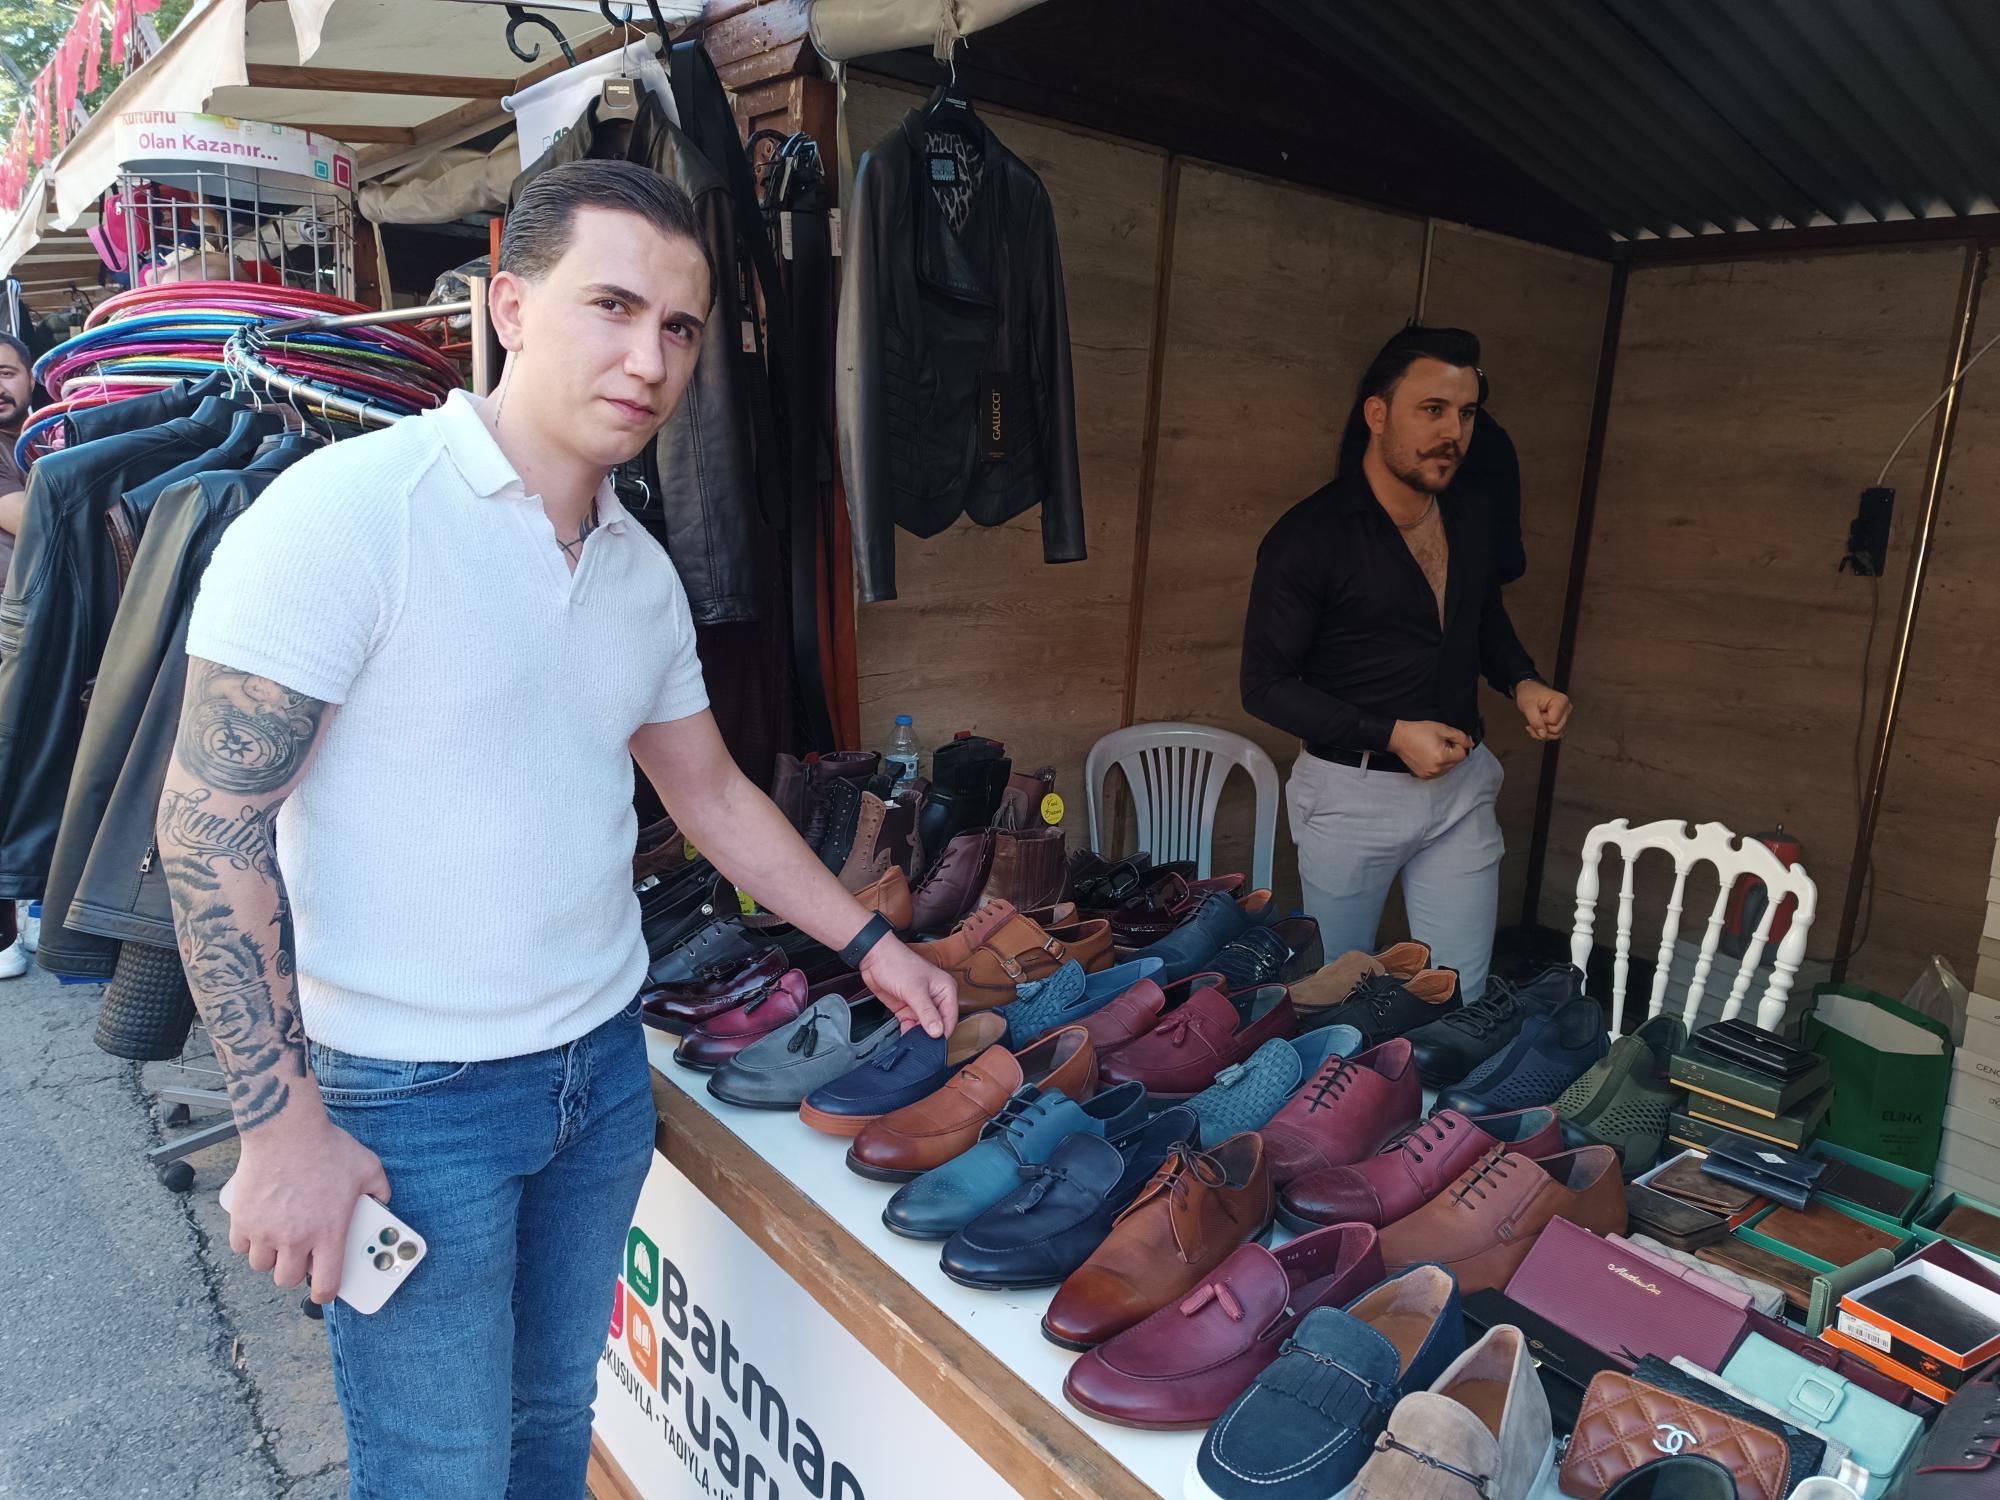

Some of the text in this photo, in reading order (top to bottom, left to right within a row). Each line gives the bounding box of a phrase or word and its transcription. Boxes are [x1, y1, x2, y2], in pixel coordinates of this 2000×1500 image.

[138, 133, 177, 150] Olan
[992, 392, 1001, 441] GALUCCI
[662, 1414, 710, 1496] TADIYLA
